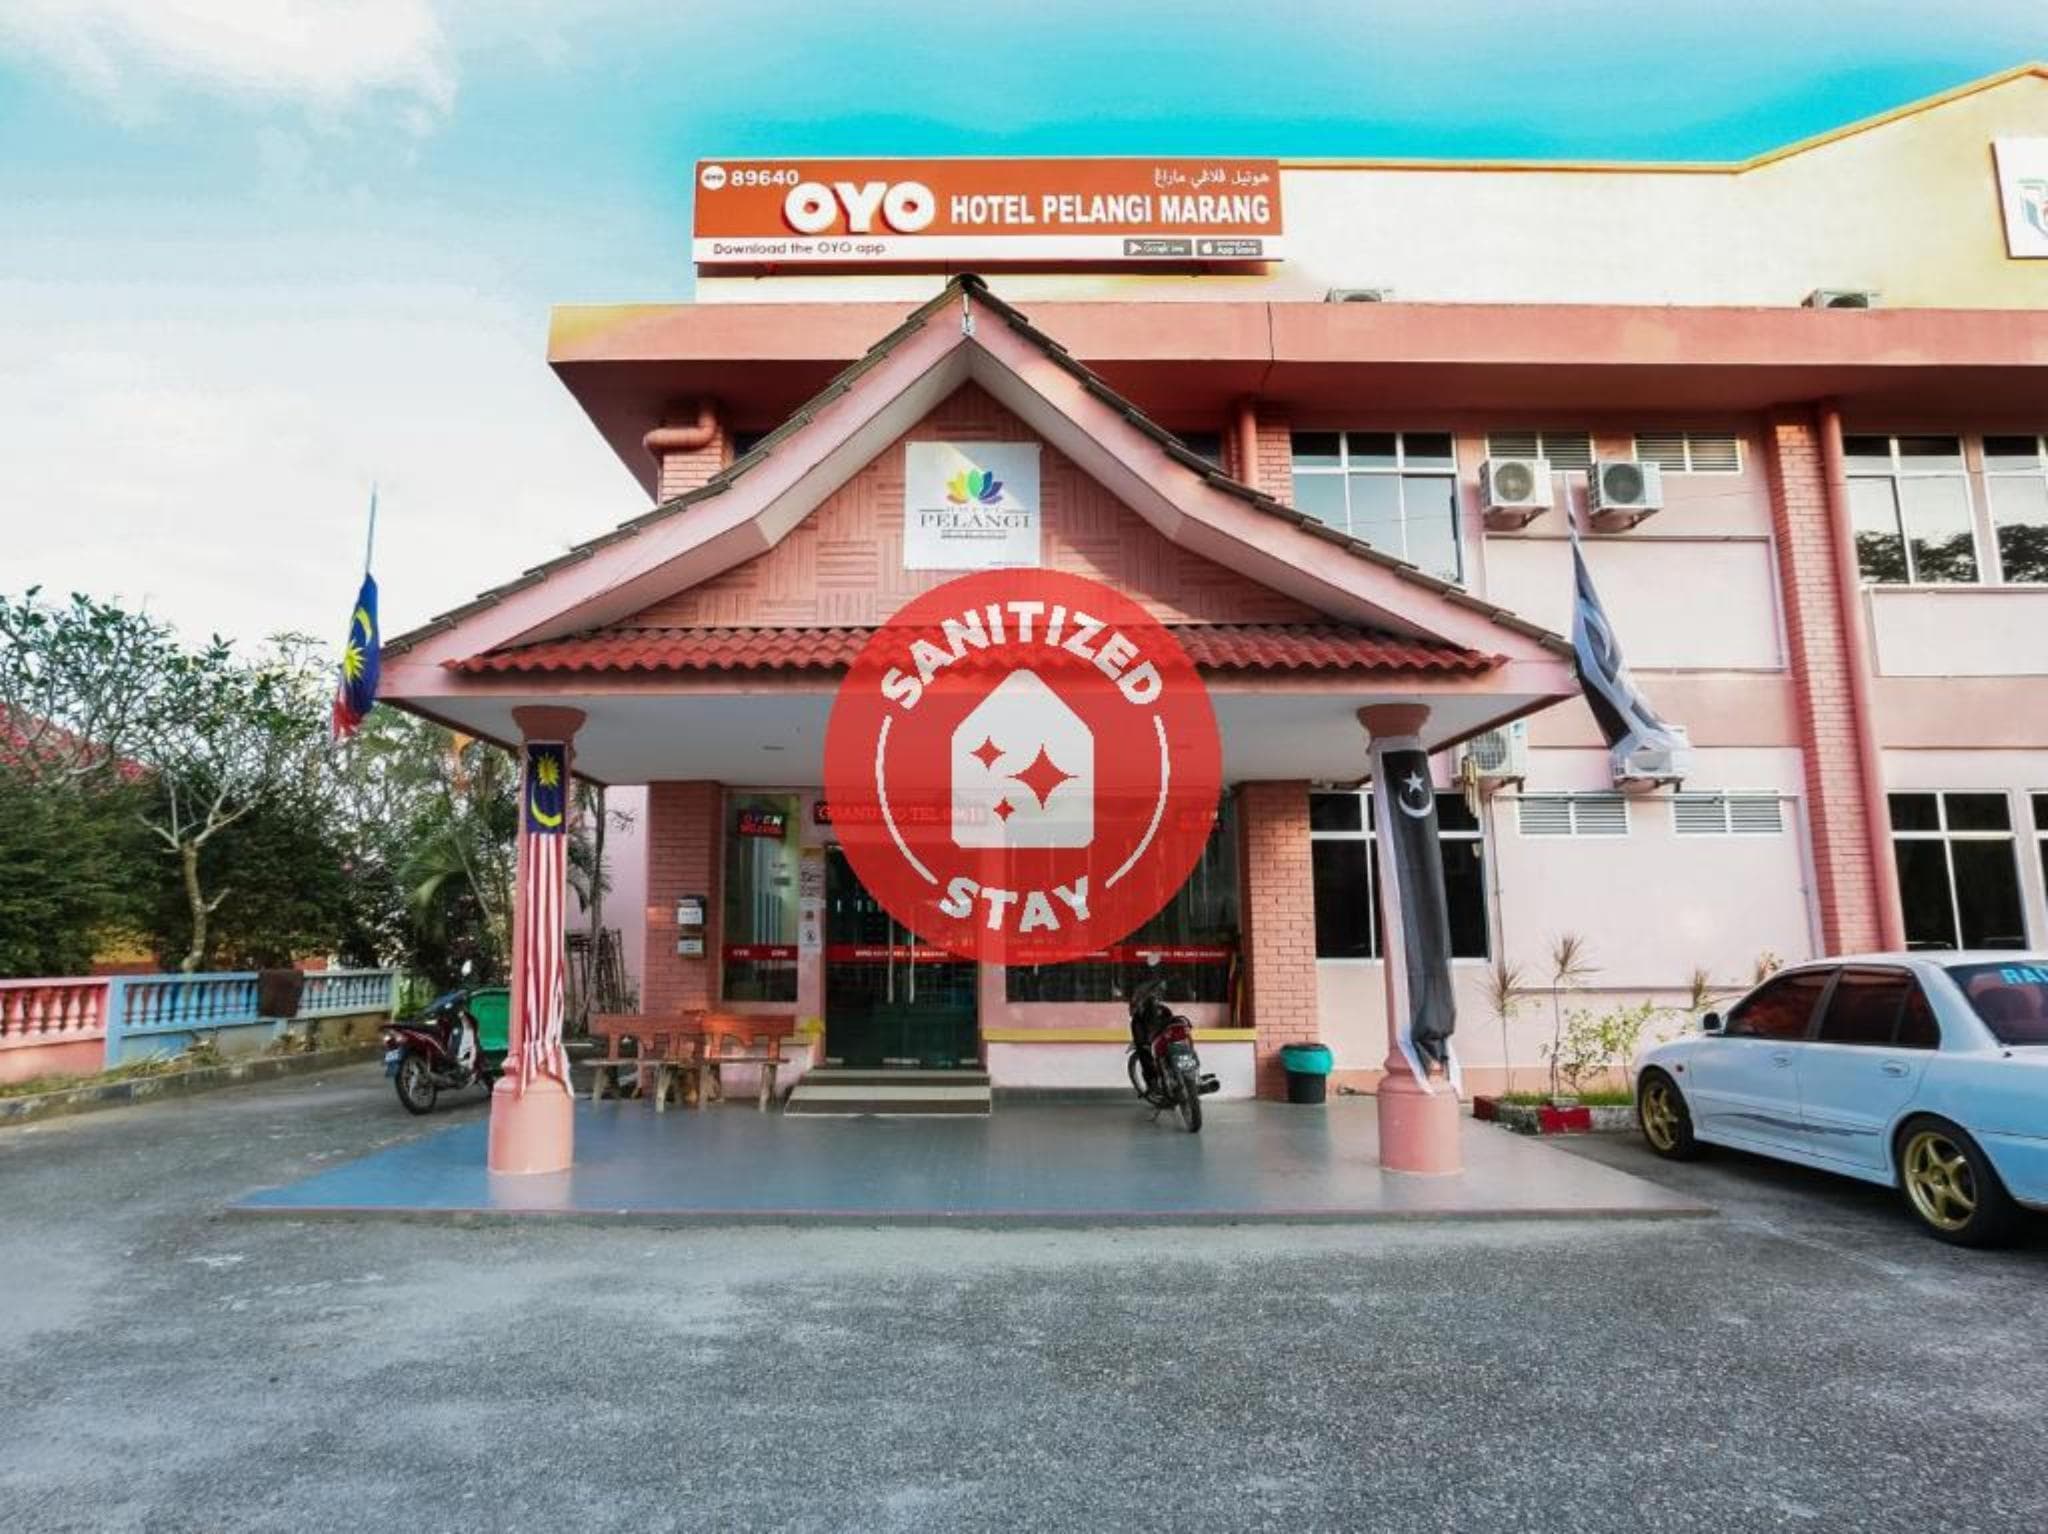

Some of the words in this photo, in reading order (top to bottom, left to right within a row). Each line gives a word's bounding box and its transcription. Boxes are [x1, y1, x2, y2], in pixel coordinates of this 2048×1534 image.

[730, 169, 799, 186] 89640
[783, 181, 936, 234] OYO
[950, 195, 1036, 224] HOTEL
[1042, 195, 1152, 224] PELANGI
[1160, 195, 1271, 225] MARANG
[712, 241, 787, 255] Download
[790, 242, 813, 255] the
[817, 241, 852, 255] OYO
[855, 244, 886, 257] app
[920, 513, 1030, 528] PELANGI
